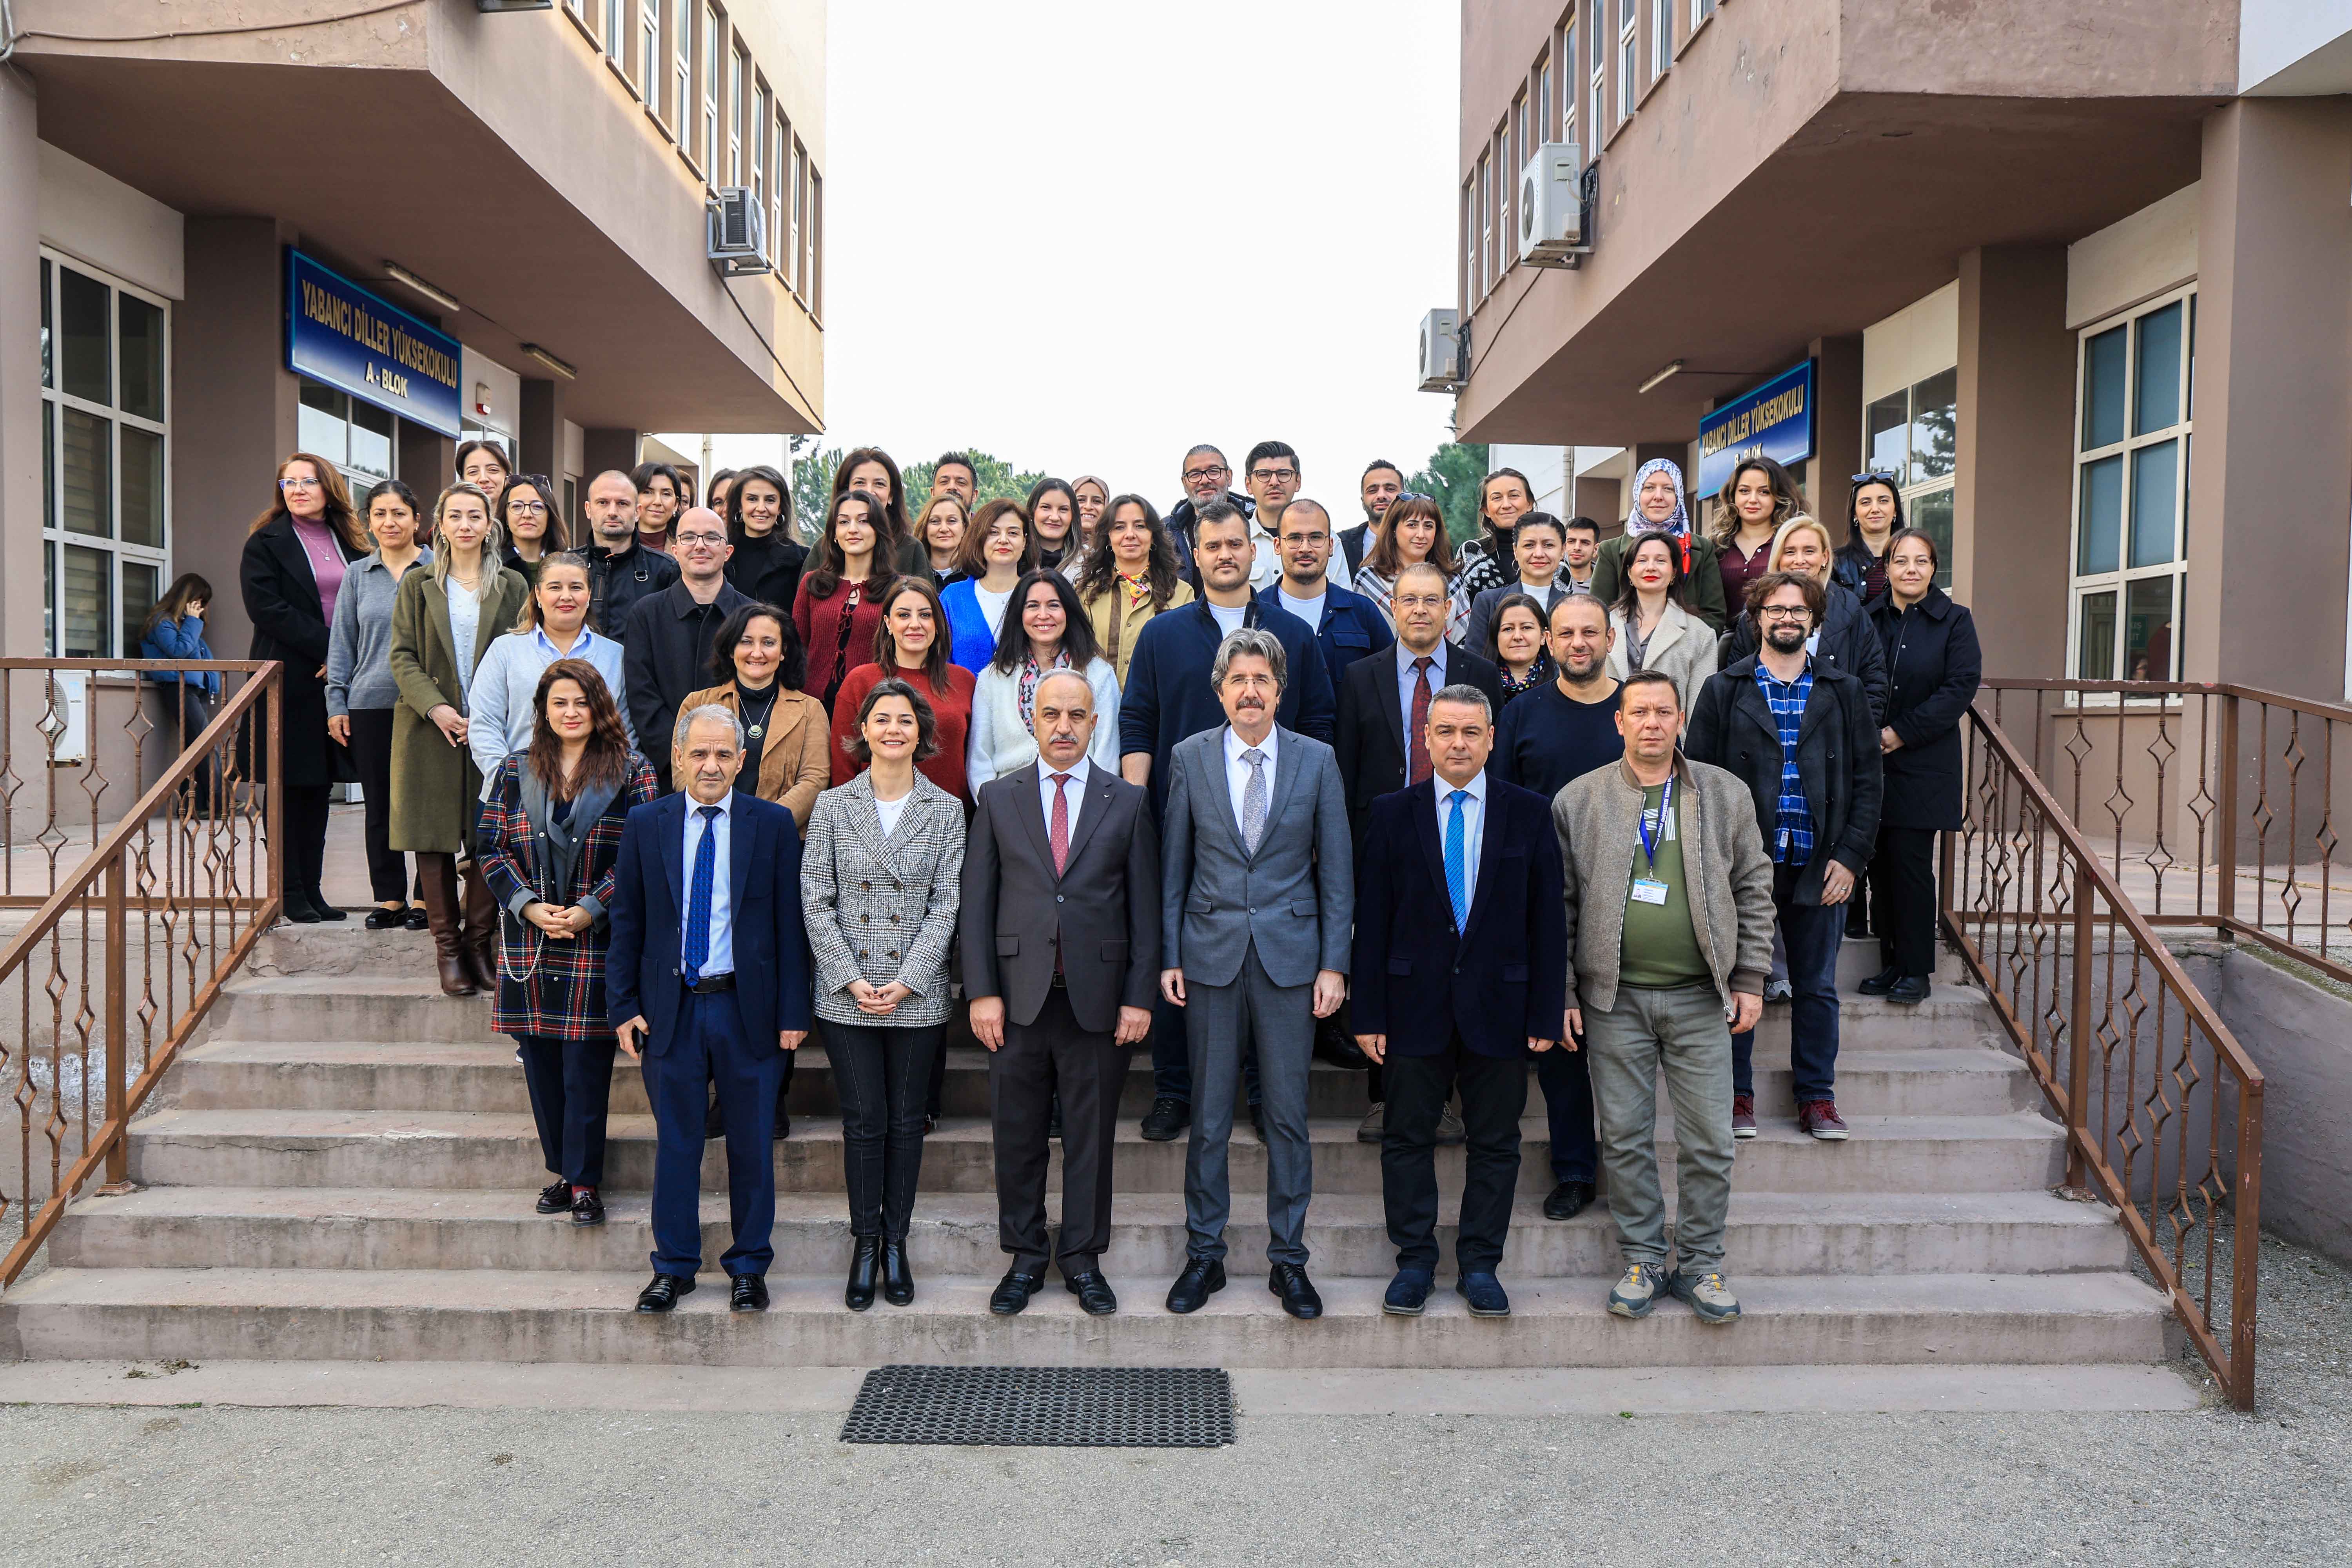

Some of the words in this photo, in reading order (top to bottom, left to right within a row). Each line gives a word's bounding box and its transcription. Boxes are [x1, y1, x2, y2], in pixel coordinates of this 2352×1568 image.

[302, 279, 351, 337] YABANCI
[354, 303, 390, 356] DİLLER
[392, 325, 457, 389] YÜKSEKOKULU
[365, 361, 374, 383] A
[381, 368, 408, 398] BLOK
[1702, 423, 1726, 458] YABANCI
[1728, 412, 1749, 446] DİLLER
[1751, 383, 1804, 435] YÜKSEKOKULU
[1735, 454, 1740, 470] B
